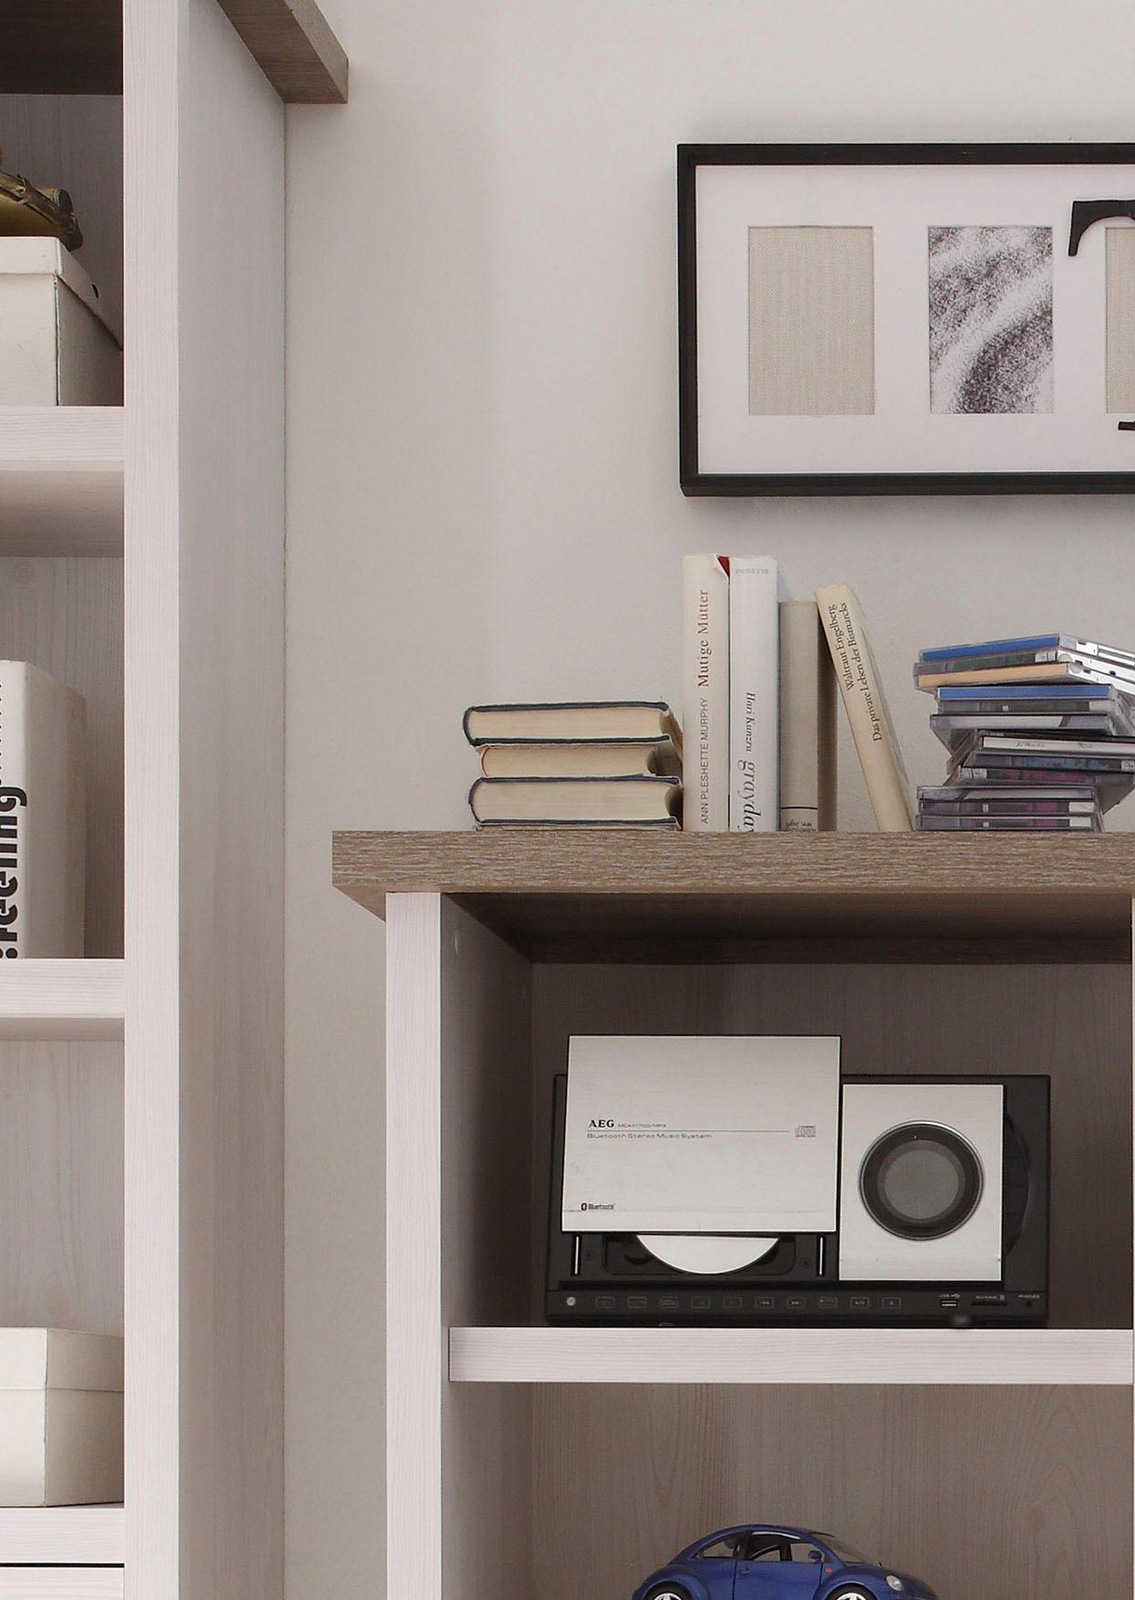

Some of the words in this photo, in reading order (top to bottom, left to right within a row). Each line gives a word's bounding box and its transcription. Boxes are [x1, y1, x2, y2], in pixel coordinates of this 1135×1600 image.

[698, 590, 709, 634] Mütter
[828, 604, 845, 650] Engelberg
[839, 602, 857, 647] Bismarcks
[698, 640, 712, 687] Mutige
[840, 651, 854, 691] Waltraut
[852, 648, 861, 663] der
[857, 663, 869, 691] Leben
[700, 698, 709, 740] MURPHY
[746, 692, 756, 714] Hari
[864, 692, 880, 723] private
[872, 722, 882, 741] Das
[700, 743, 709, 800] PLESHETTE
[700, 803, 709, 824] ANN
[588, 1119, 614, 1128] AEG
